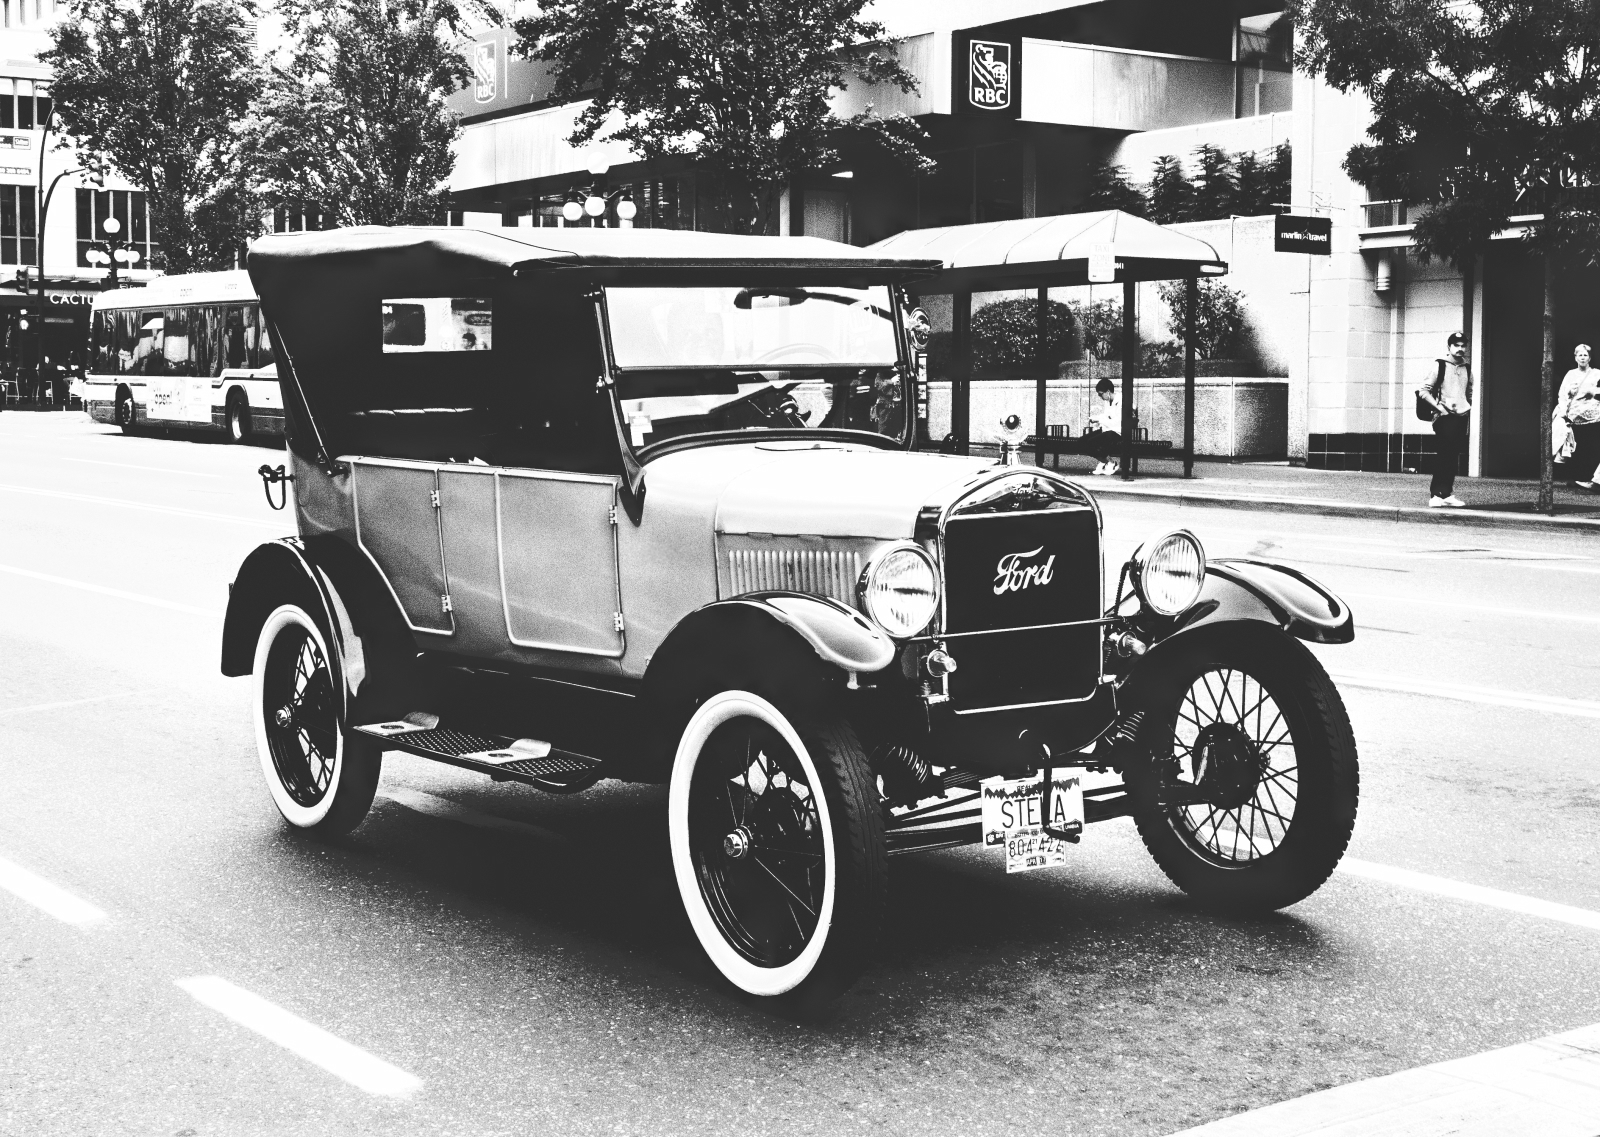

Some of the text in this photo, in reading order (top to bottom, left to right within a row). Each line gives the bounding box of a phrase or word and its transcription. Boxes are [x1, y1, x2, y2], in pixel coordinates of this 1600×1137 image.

[477, 83, 494, 98] RBC
[974, 87, 1006, 104] RBC
[1281, 231, 1327, 241] marlin travel
[50, 293, 95, 305] CACTU
[993, 545, 1056, 595] Ford
[1001, 794, 1066, 828] STEA
